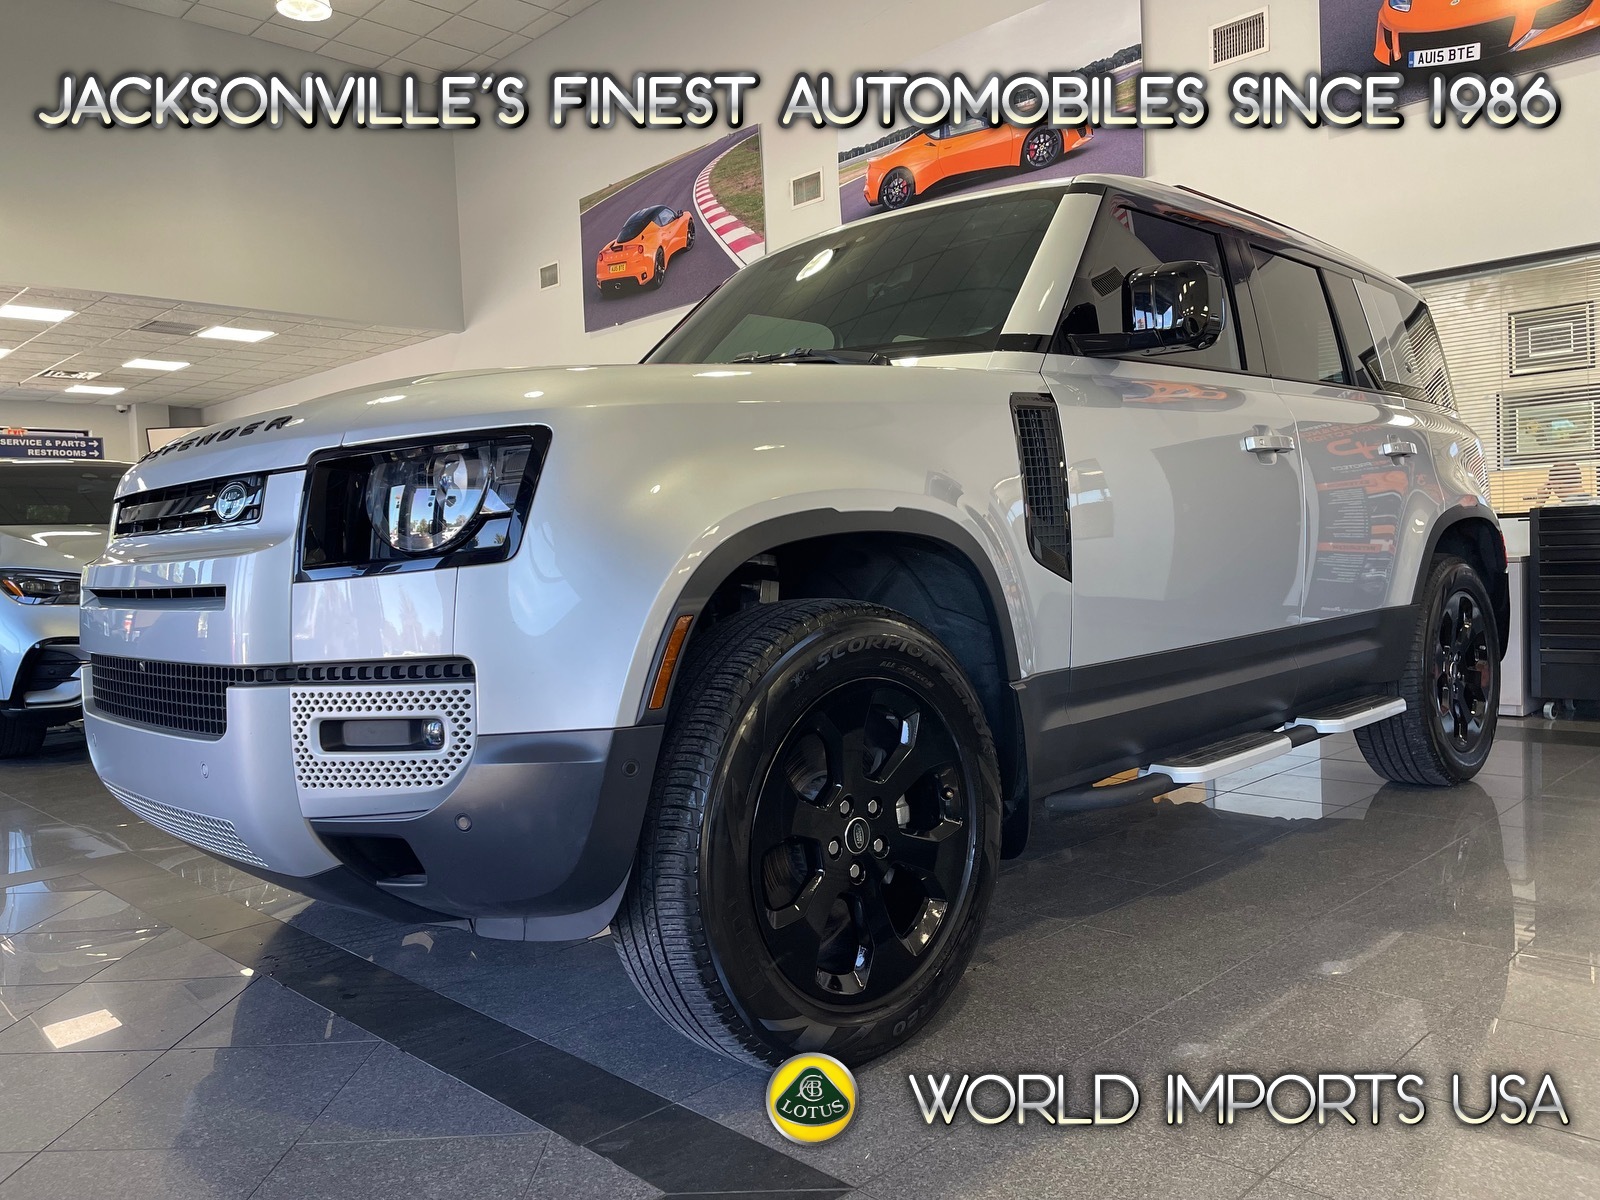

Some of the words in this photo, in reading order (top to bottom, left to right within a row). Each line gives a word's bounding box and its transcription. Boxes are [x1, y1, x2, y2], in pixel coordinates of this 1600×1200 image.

[1418, 50, 1444, 65] AU15
[1448, 45, 1475, 62] BTE
[0, 438, 42, 447] SERVICE
[45, 439, 52, 447] &
[55, 440, 86, 448] PARTS
[27, 448, 87, 458] RESTROOMS
[816, 634, 938, 671] SCORPION
